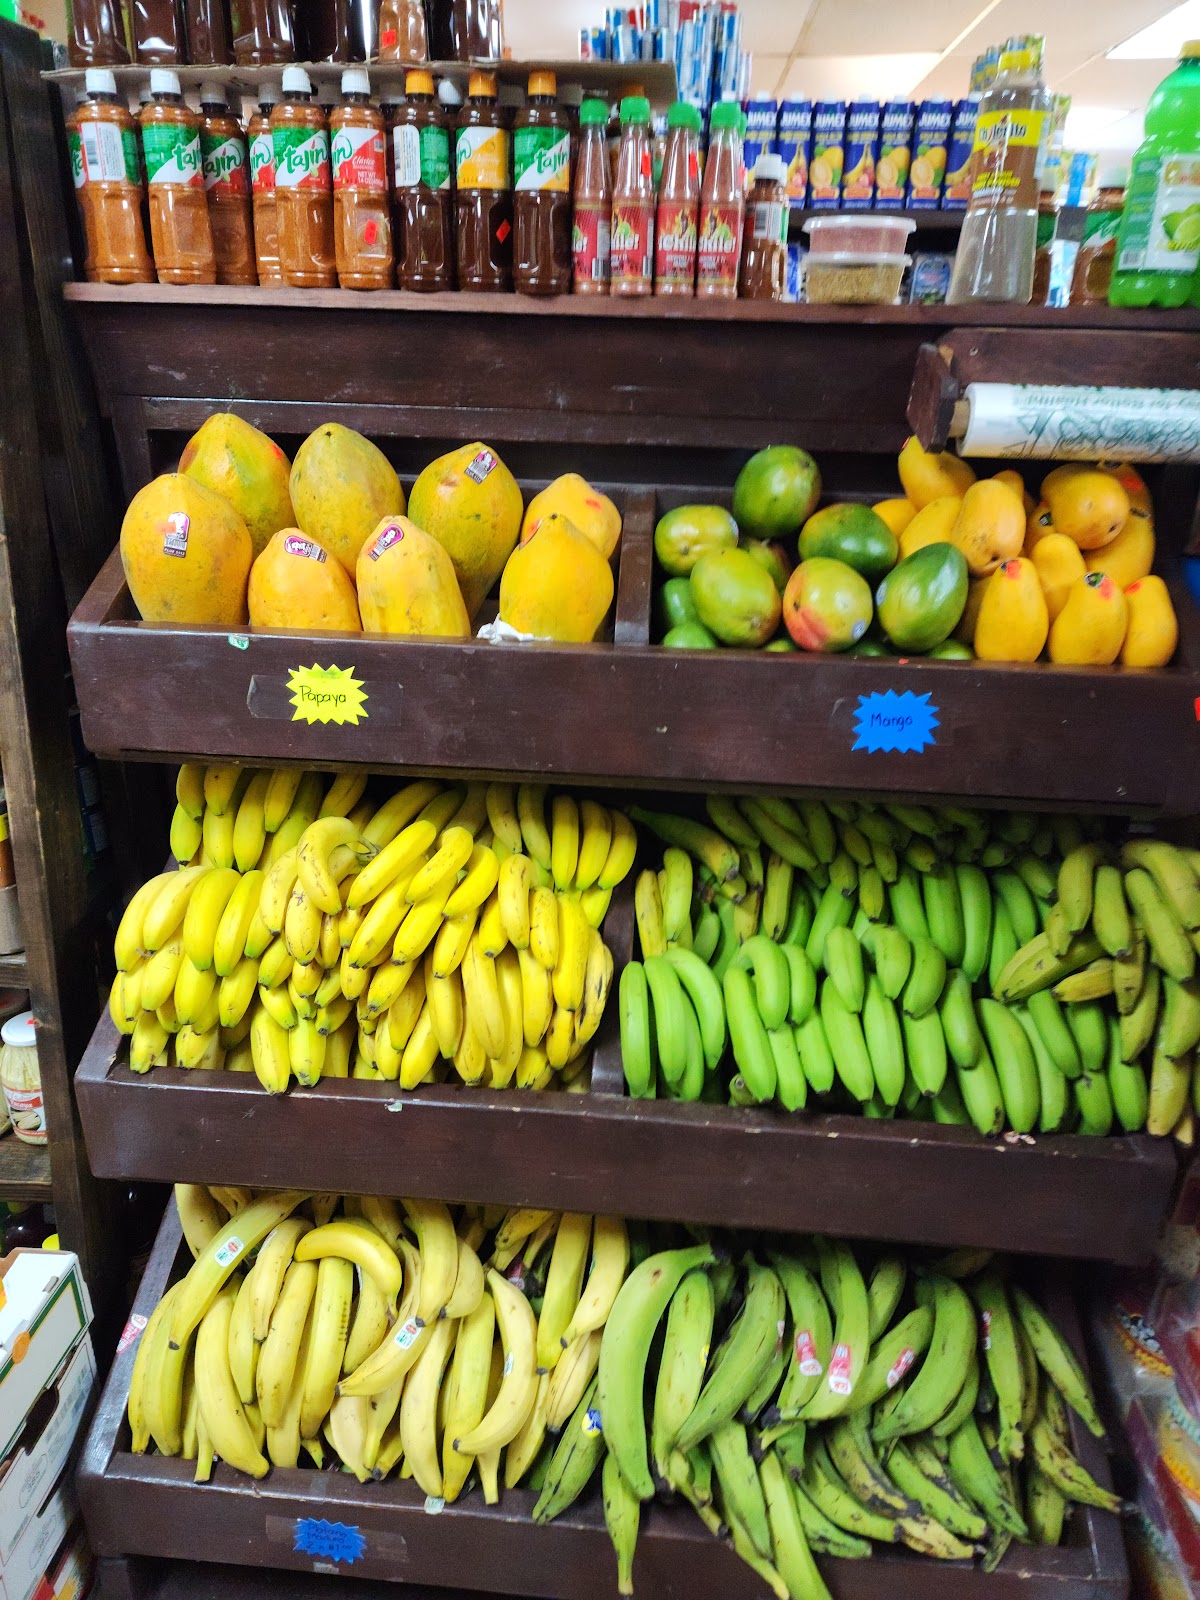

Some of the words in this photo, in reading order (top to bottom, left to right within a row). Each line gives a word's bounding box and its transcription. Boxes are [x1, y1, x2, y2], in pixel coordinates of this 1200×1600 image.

[746, 111, 778, 127] JUMEX
[780, 112, 812, 127] JUMEX
[814, 113, 846, 128] JUMEX
[848, 112, 880, 127] JUMEX
[882, 112, 915, 127] JUMEX
[919, 112, 953, 127] JUMEX
[955, 112, 978, 127] JUM
[300, 685, 347, 708] Papaya
[870, 712, 913, 732] Mango
